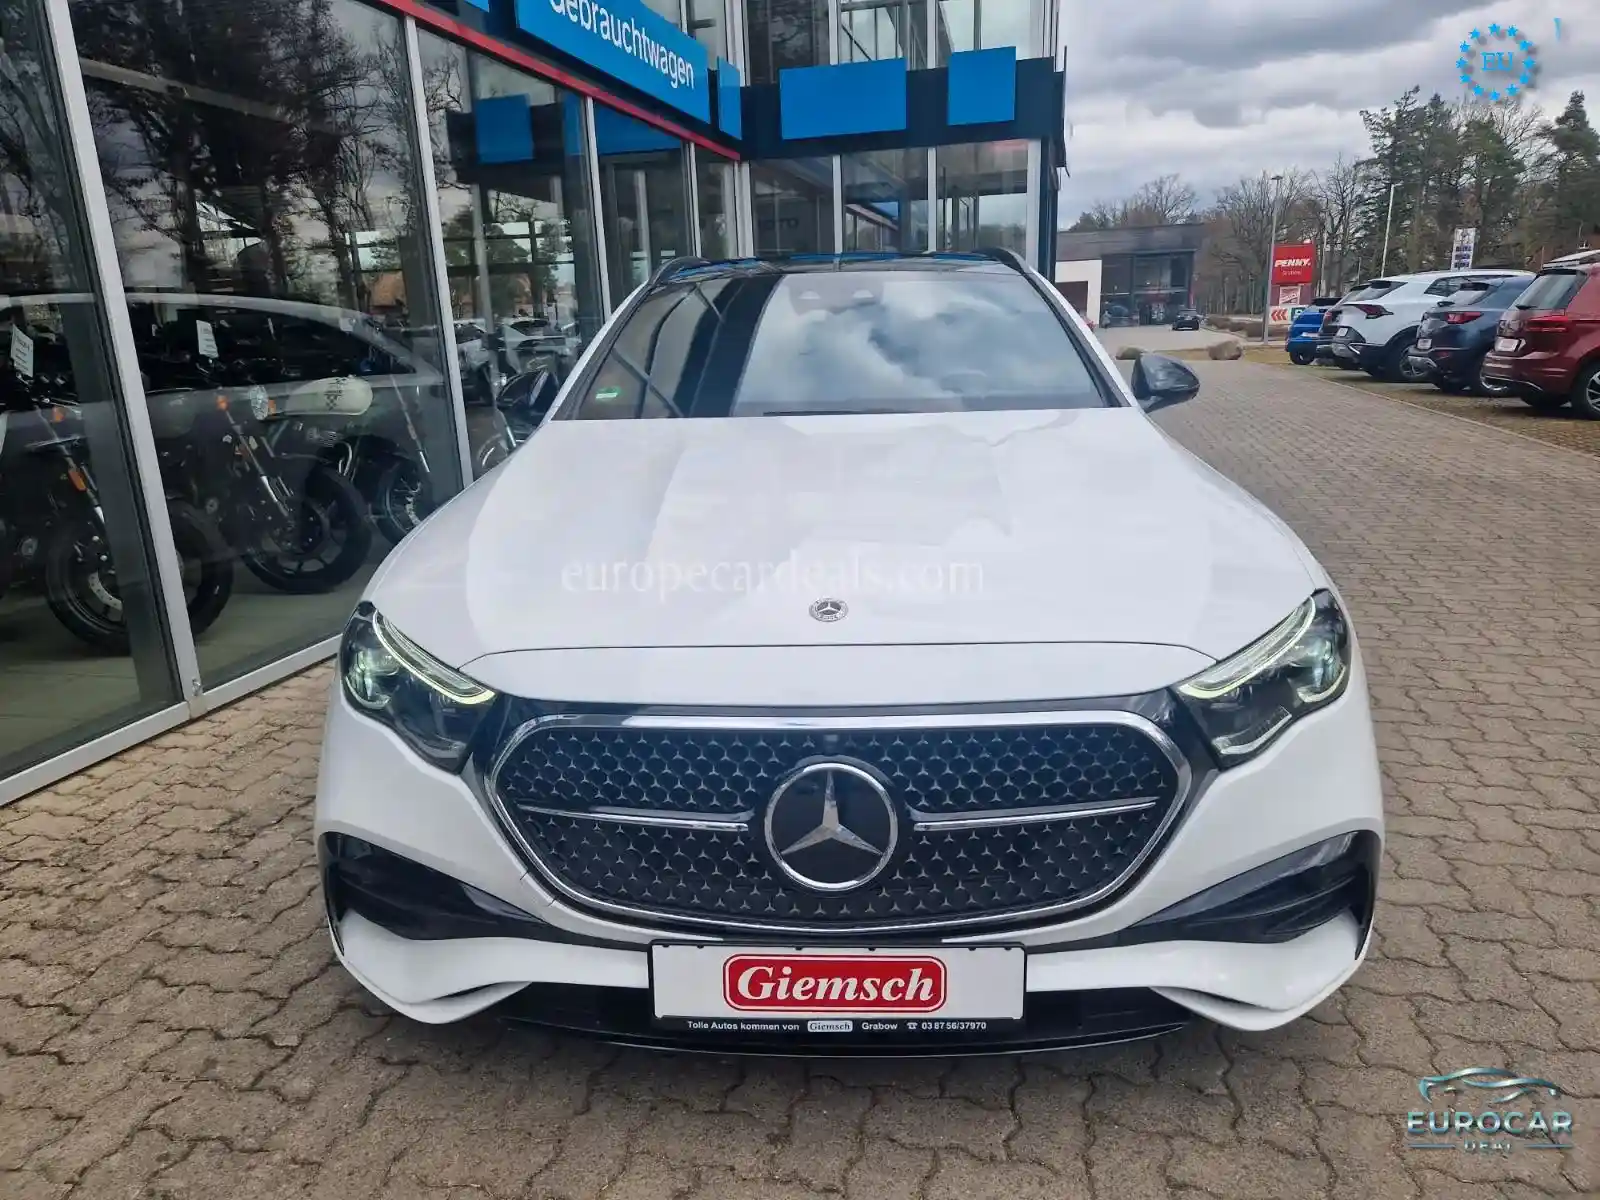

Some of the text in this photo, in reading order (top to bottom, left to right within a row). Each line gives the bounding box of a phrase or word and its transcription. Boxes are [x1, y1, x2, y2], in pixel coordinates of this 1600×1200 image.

[737, 965, 934, 1001] Giemsch
[687, 1020, 709, 1030] Tolle
[710, 1021, 738, 1031] Autos
[740, 1022, 780, 1031] kommen
[809, 1022, 850, 1031] Giemsch
[861, 1022, 898, 1031] Grabow
